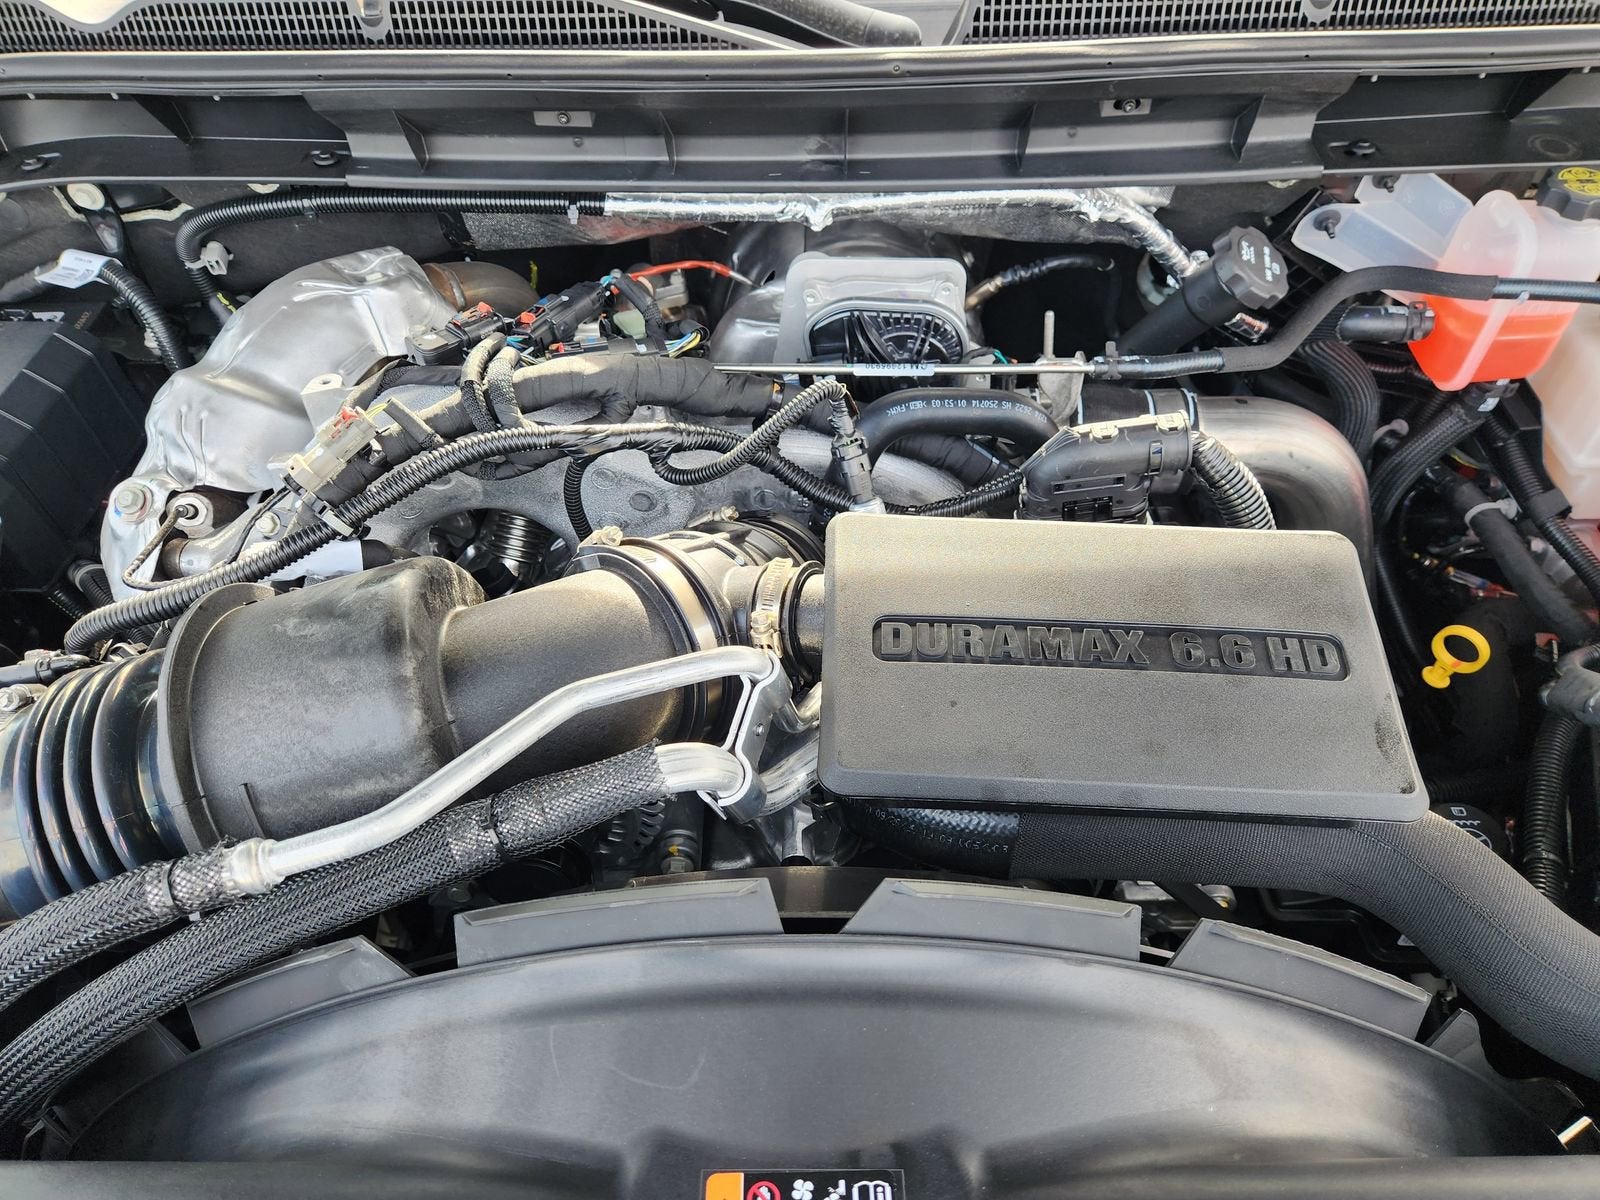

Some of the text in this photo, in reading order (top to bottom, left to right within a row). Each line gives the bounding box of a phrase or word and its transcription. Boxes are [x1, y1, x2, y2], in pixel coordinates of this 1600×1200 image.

[971, 399, 999, 409] 250714
[1001, 401, 1012, 410] HS
[880, 621, 1342, 676] DURAMAX 6.6 HD
